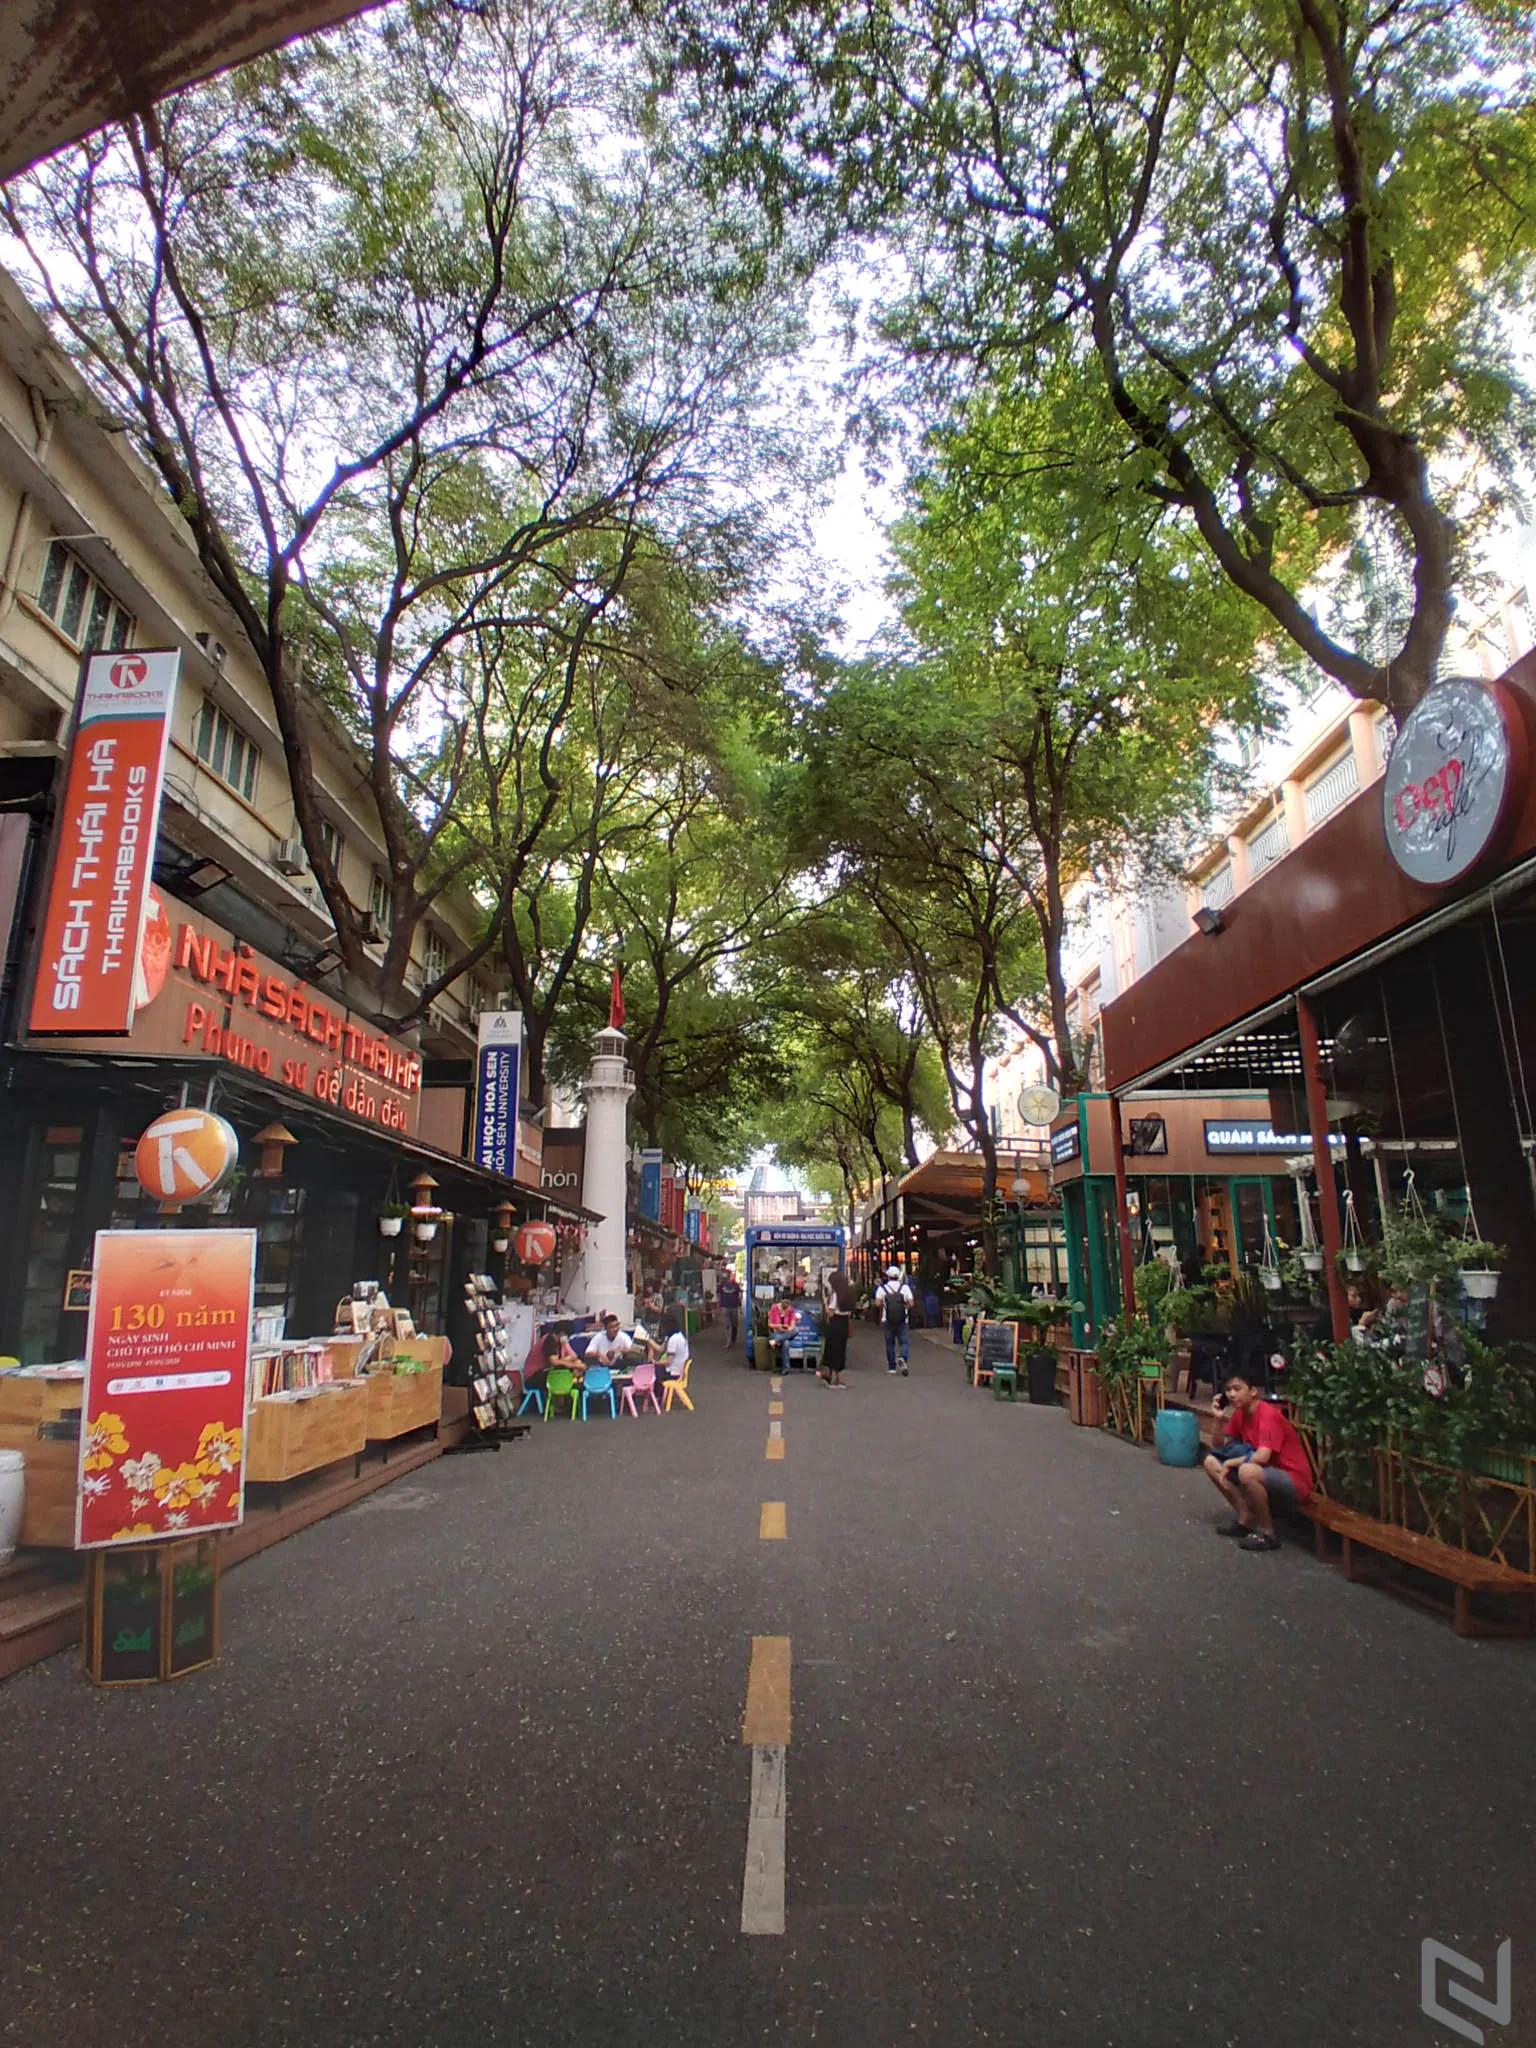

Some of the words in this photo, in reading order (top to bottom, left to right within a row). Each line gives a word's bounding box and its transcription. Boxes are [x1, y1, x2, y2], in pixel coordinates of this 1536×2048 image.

[87, 738, 117, 791] HÀ
[72, 803, 107, 888] THÁI
[102, 766, 146, 975] THAIHABOOKS
[52, 900, 93, 1010] SÁCH
[174, 923, 259, 1006] NHÀ
[258, 976, 343, 1050] SÁCH
[343, 1022, 394, 1079] THÁI
[487, 1051, 498, 1081] SEN
[485, 1082, 497, 1112] HOA
[498, 1051, 511, 1119] UNIVERSITY
[482, 1113, 496, 1148] HỌC
[496, 1123, 507, 1146] SEN
[109, 1303, 165, 1331] 130
[176, 1304, 237, 1328] năm
[135, 1345, 162, 1357] TỊCH
[207, 1339, 236, 1350] MINH
[142, 1332, 169, 1342] SINH
